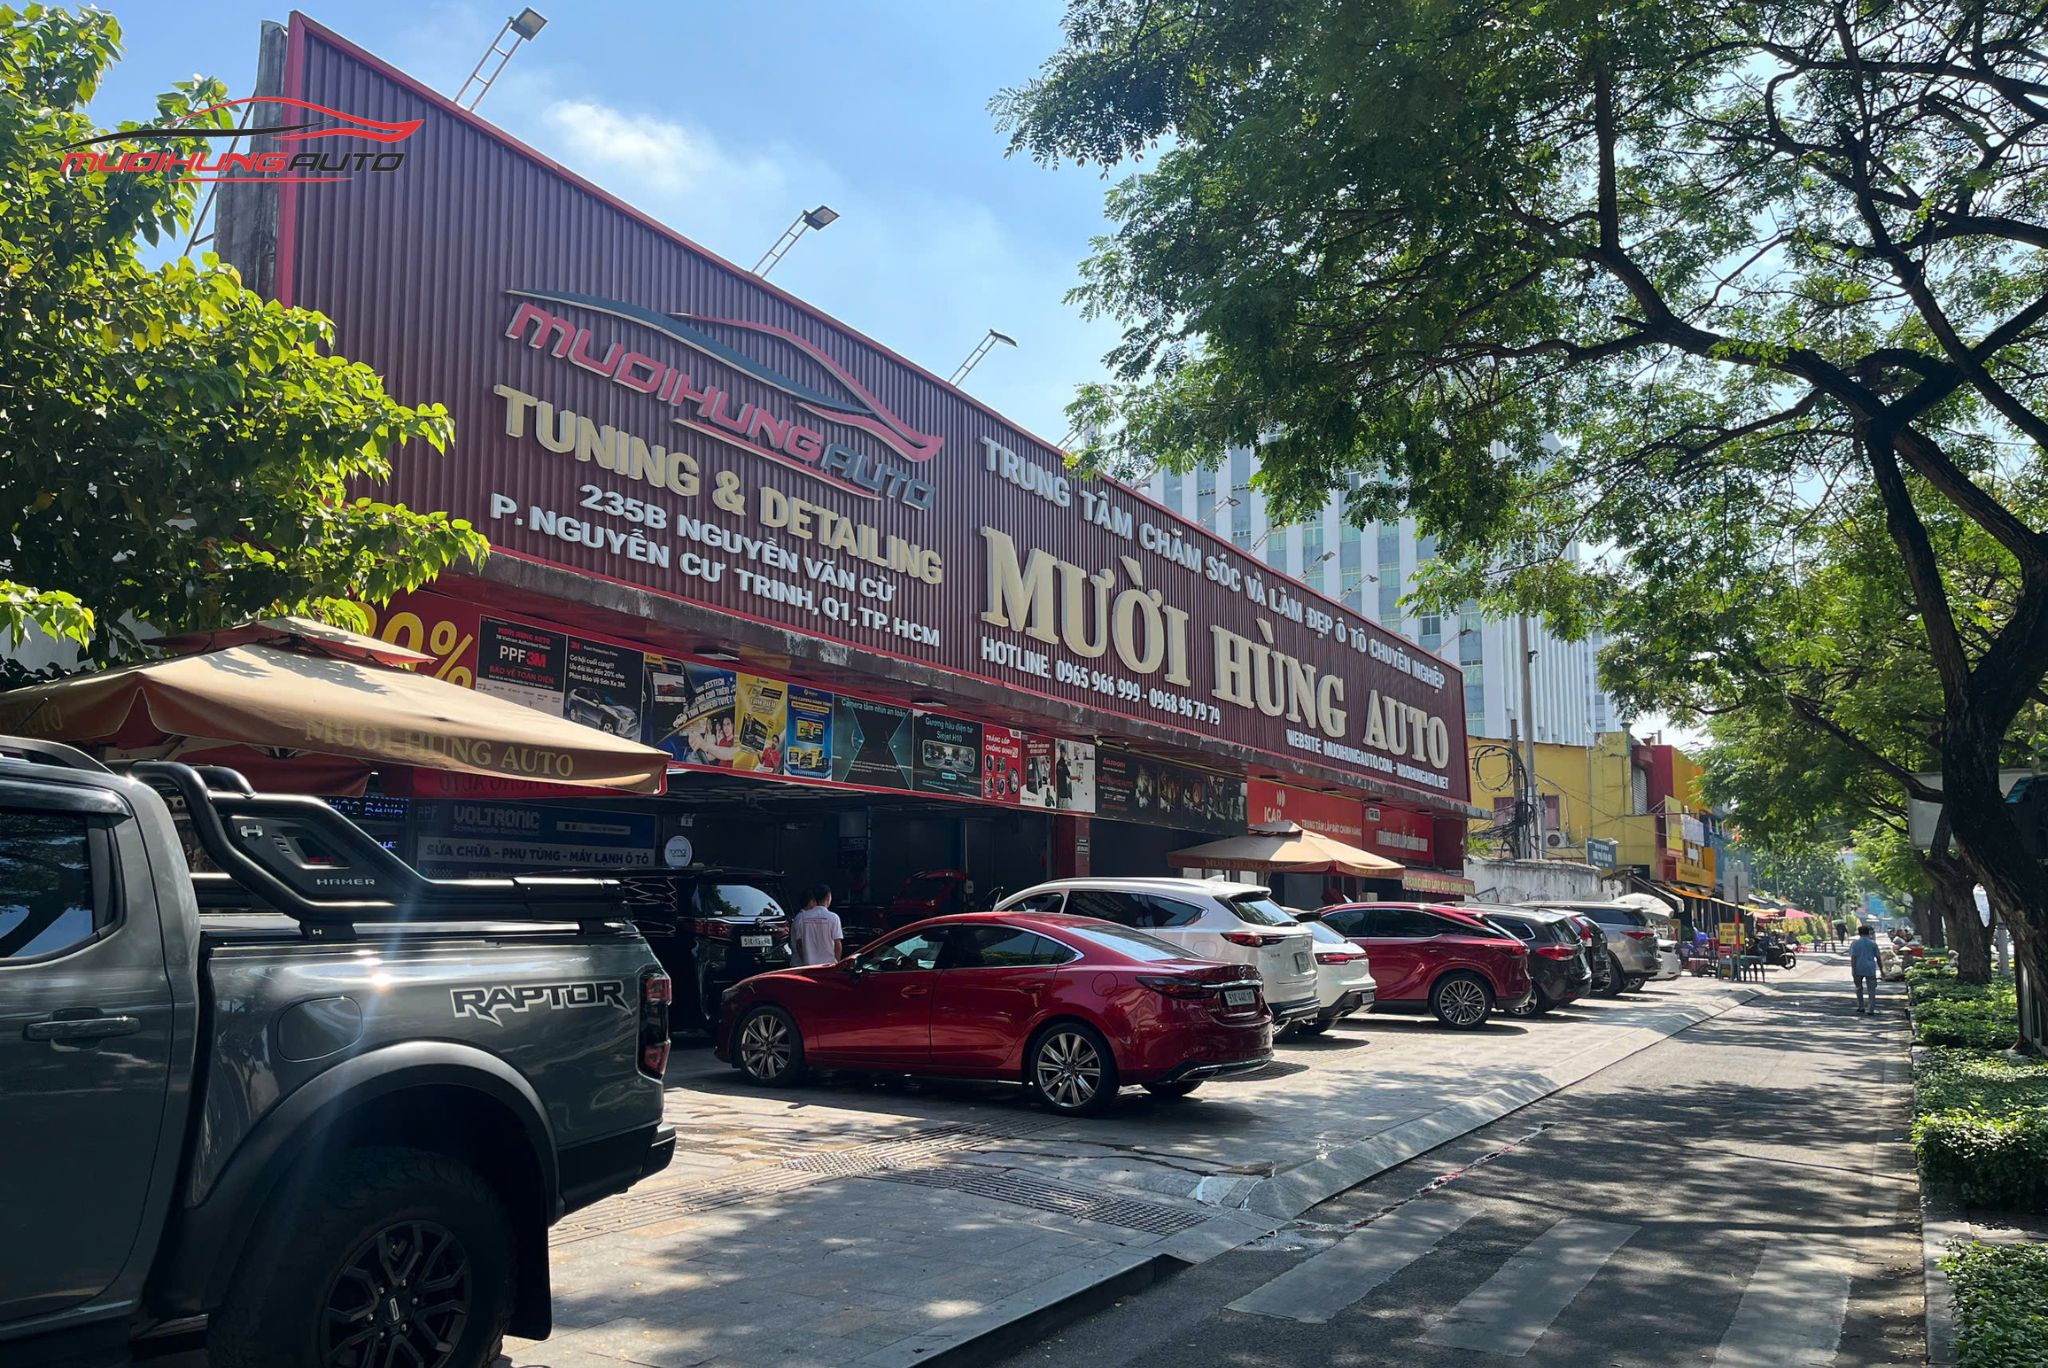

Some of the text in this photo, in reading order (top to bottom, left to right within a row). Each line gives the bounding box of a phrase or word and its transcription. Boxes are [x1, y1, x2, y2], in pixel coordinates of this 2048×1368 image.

[494, 384, 943, 585] TUNING & DETAILING
[490, 493, 523, 526] P.
[529, 506, 669, 568] NGUYỄN
[680, 552, 727, 583] CƯ
[579, 484, 897, 602] 235B NGUYỄN VĂN CỪ
[980, 436, 1445, 694] TRUNG TÂM CHĂM SÓC VÀ LÀM ĐẸP Ô TÔ CHUYÊN NGHIỆP
[500, 645, 547, 669] PPF 3M
[980, 525, 1450, 770] MƯỜI HÙNG AUTO
[841, 698, 863, 710] Camera
[1056, 659, 1089, 689] 0965
[1091, 671, 1115, 697] 966
[1116, 678, 1141, 703] 999
[1149, 687, 1177, 714] 0968
[499, 746, 575, 777] AUTO
[453, 805, 541, 830] VOLTRONIC
[1264, 807, 1282, 822] ICAR
[426, 841, 452, 858] SỬA
[457, 842, 491, 859] CHỮA
[502, 848, 527, 862] PHỤ
[530, 847, 561, 862] TÙNG
[569, 849, 593, 864] MÁY
[595, 853, 623, 867] LẠNH
[625, 852, 633, 865] Ô
[635, 851, 649, 865] TÔ
[316, 878, 376, 886] HAMER
[450, 980, 637, 1028] RAPTOR
